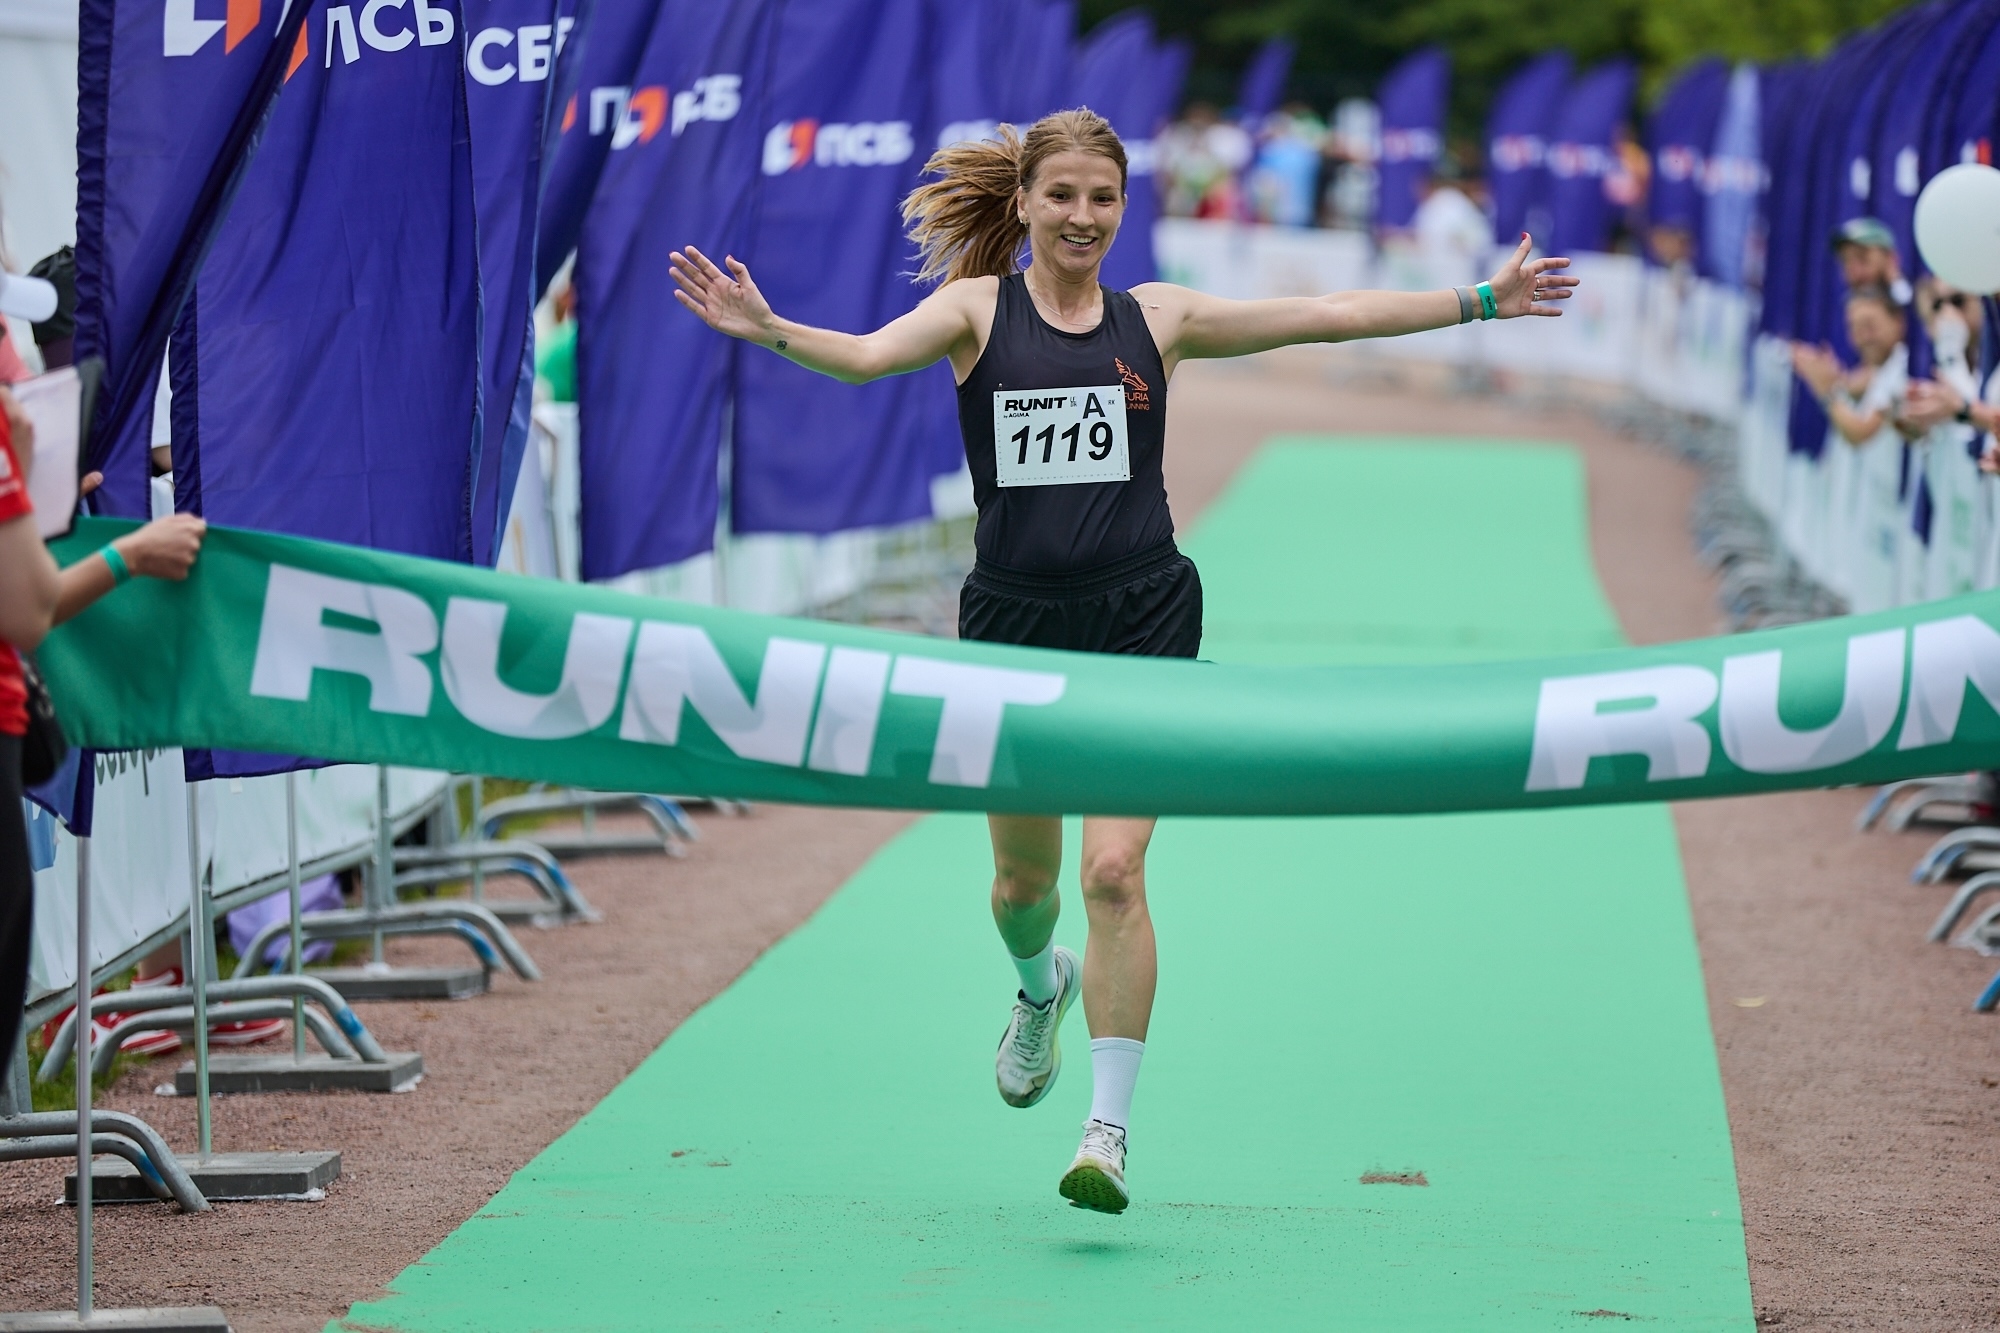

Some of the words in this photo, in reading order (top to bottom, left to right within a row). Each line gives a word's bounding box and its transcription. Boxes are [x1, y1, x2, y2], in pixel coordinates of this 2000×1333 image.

[464, 23, 553, 87] СБ
[814, 120, 914, 168] ПСБ
[1004, 396, 1068, 412] RUNIT
[1082, 392, 1106, 419] A
[1126, 403, 1150, 411] UNNING
[1011, 421, 1114, 465] 1119
[250, 563, 1066, 788] RUNIT
